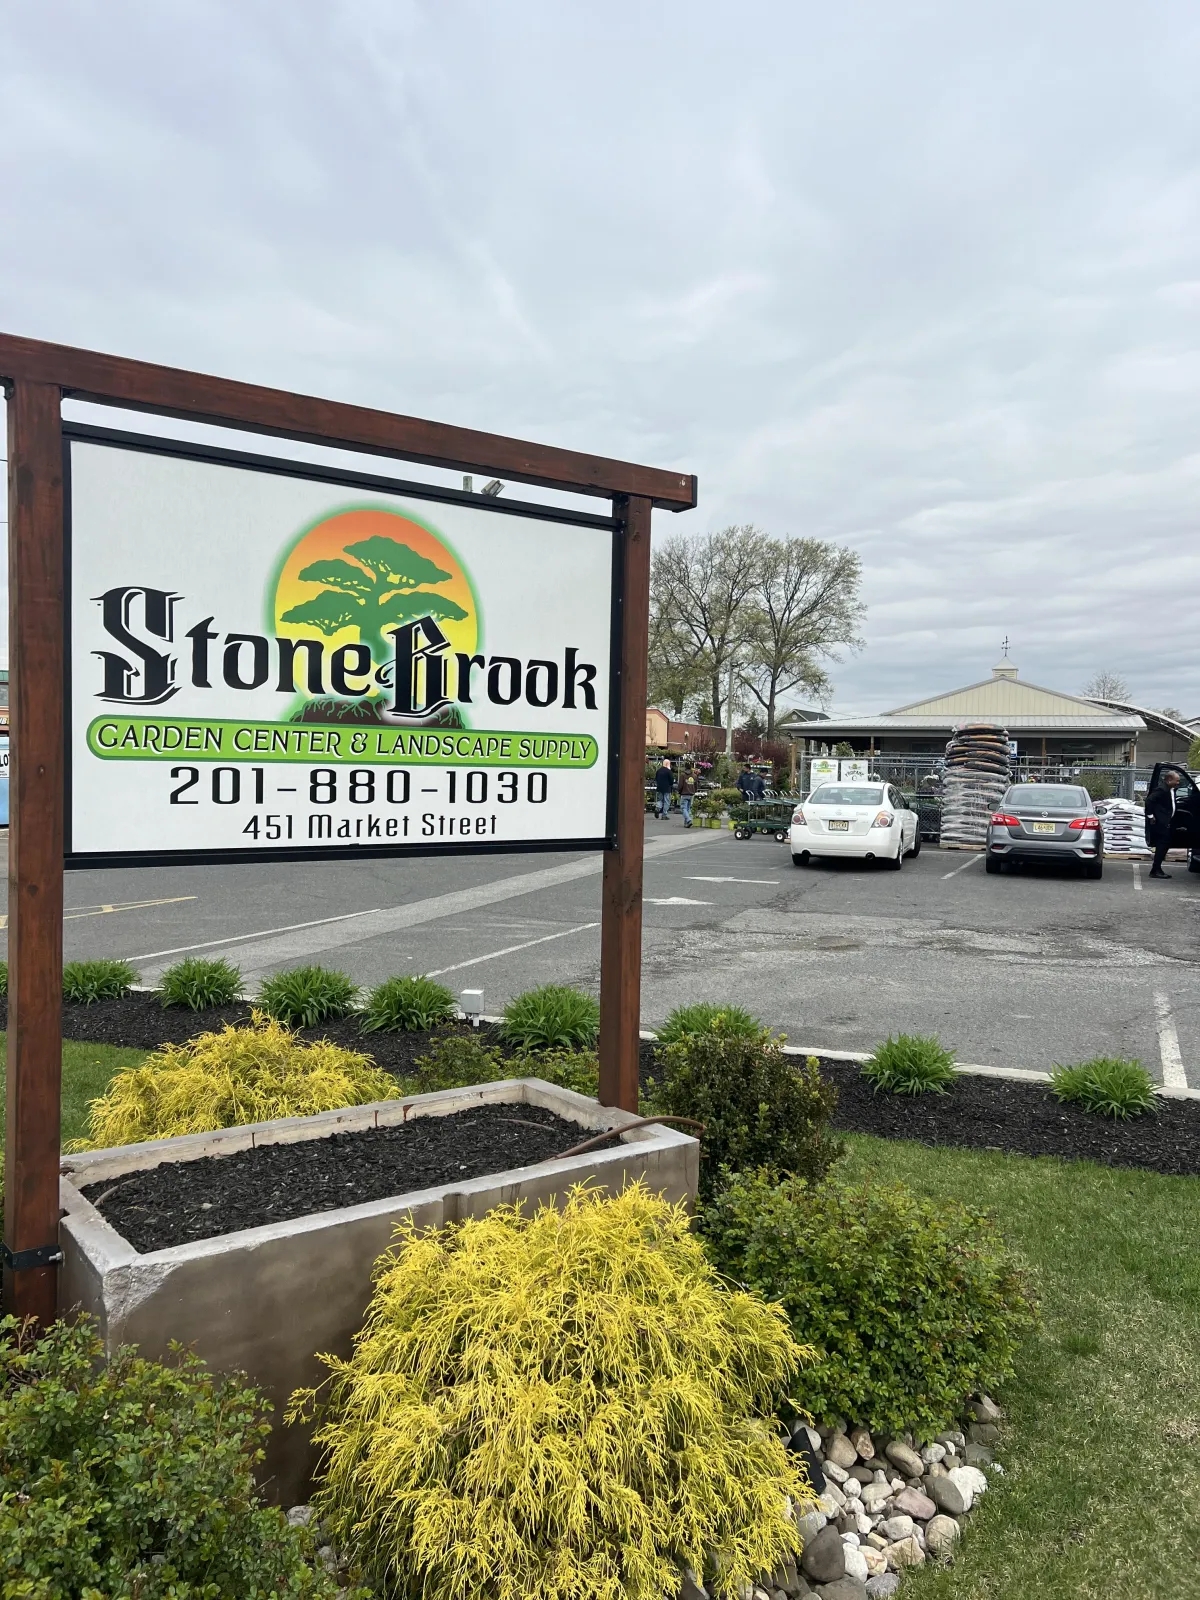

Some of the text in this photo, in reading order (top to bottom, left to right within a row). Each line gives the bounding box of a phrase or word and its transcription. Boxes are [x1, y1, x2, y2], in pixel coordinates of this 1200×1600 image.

[96, 723, 592, 761] GARDEN CENTER & LANDSCAPE SUPPLY
[169, 766, 548, 805] 201-880-1030
[242, 813, 497, 840] 451 Market Street
